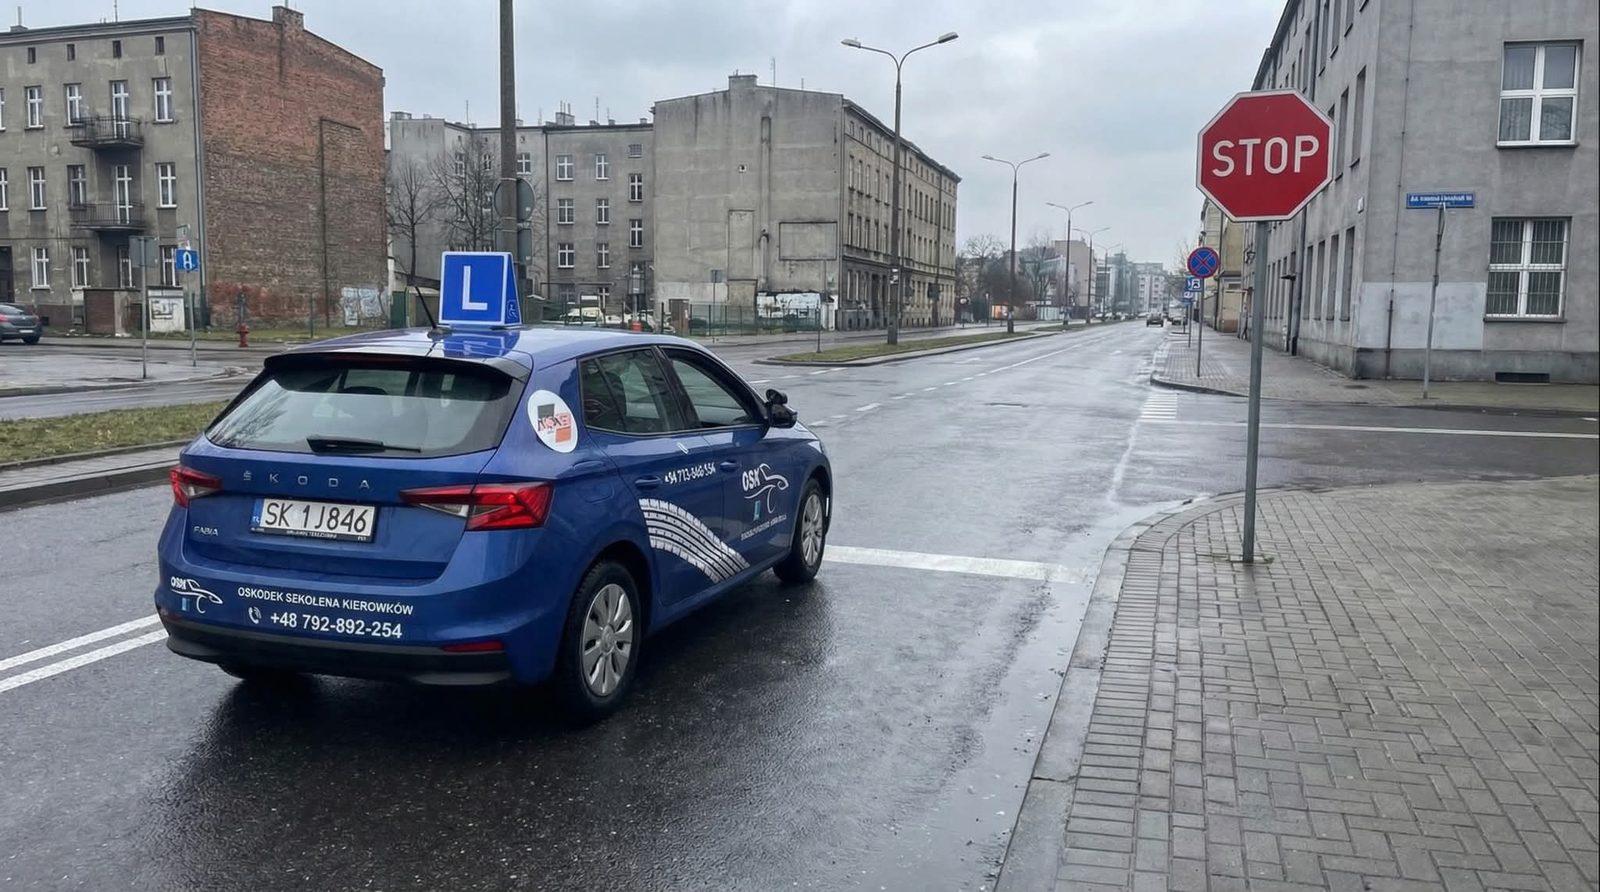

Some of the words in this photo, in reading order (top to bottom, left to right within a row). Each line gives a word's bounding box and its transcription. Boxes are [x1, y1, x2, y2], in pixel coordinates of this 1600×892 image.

[1212, 135, 1320, 177] STOP
[462, 265, 488, 311] L
[265, 502, 293, 527] SK
[302, 504, 369, 533] 1J846
[237, 586, 284, 602] OSKODEK
[285, 593, 340, 608] SEKOLENA
[342, 599, 414, 616] KIEROWKÓW
[270, 612, 298, 628] +48
[302, 614, 402, 639] 792-892-254
